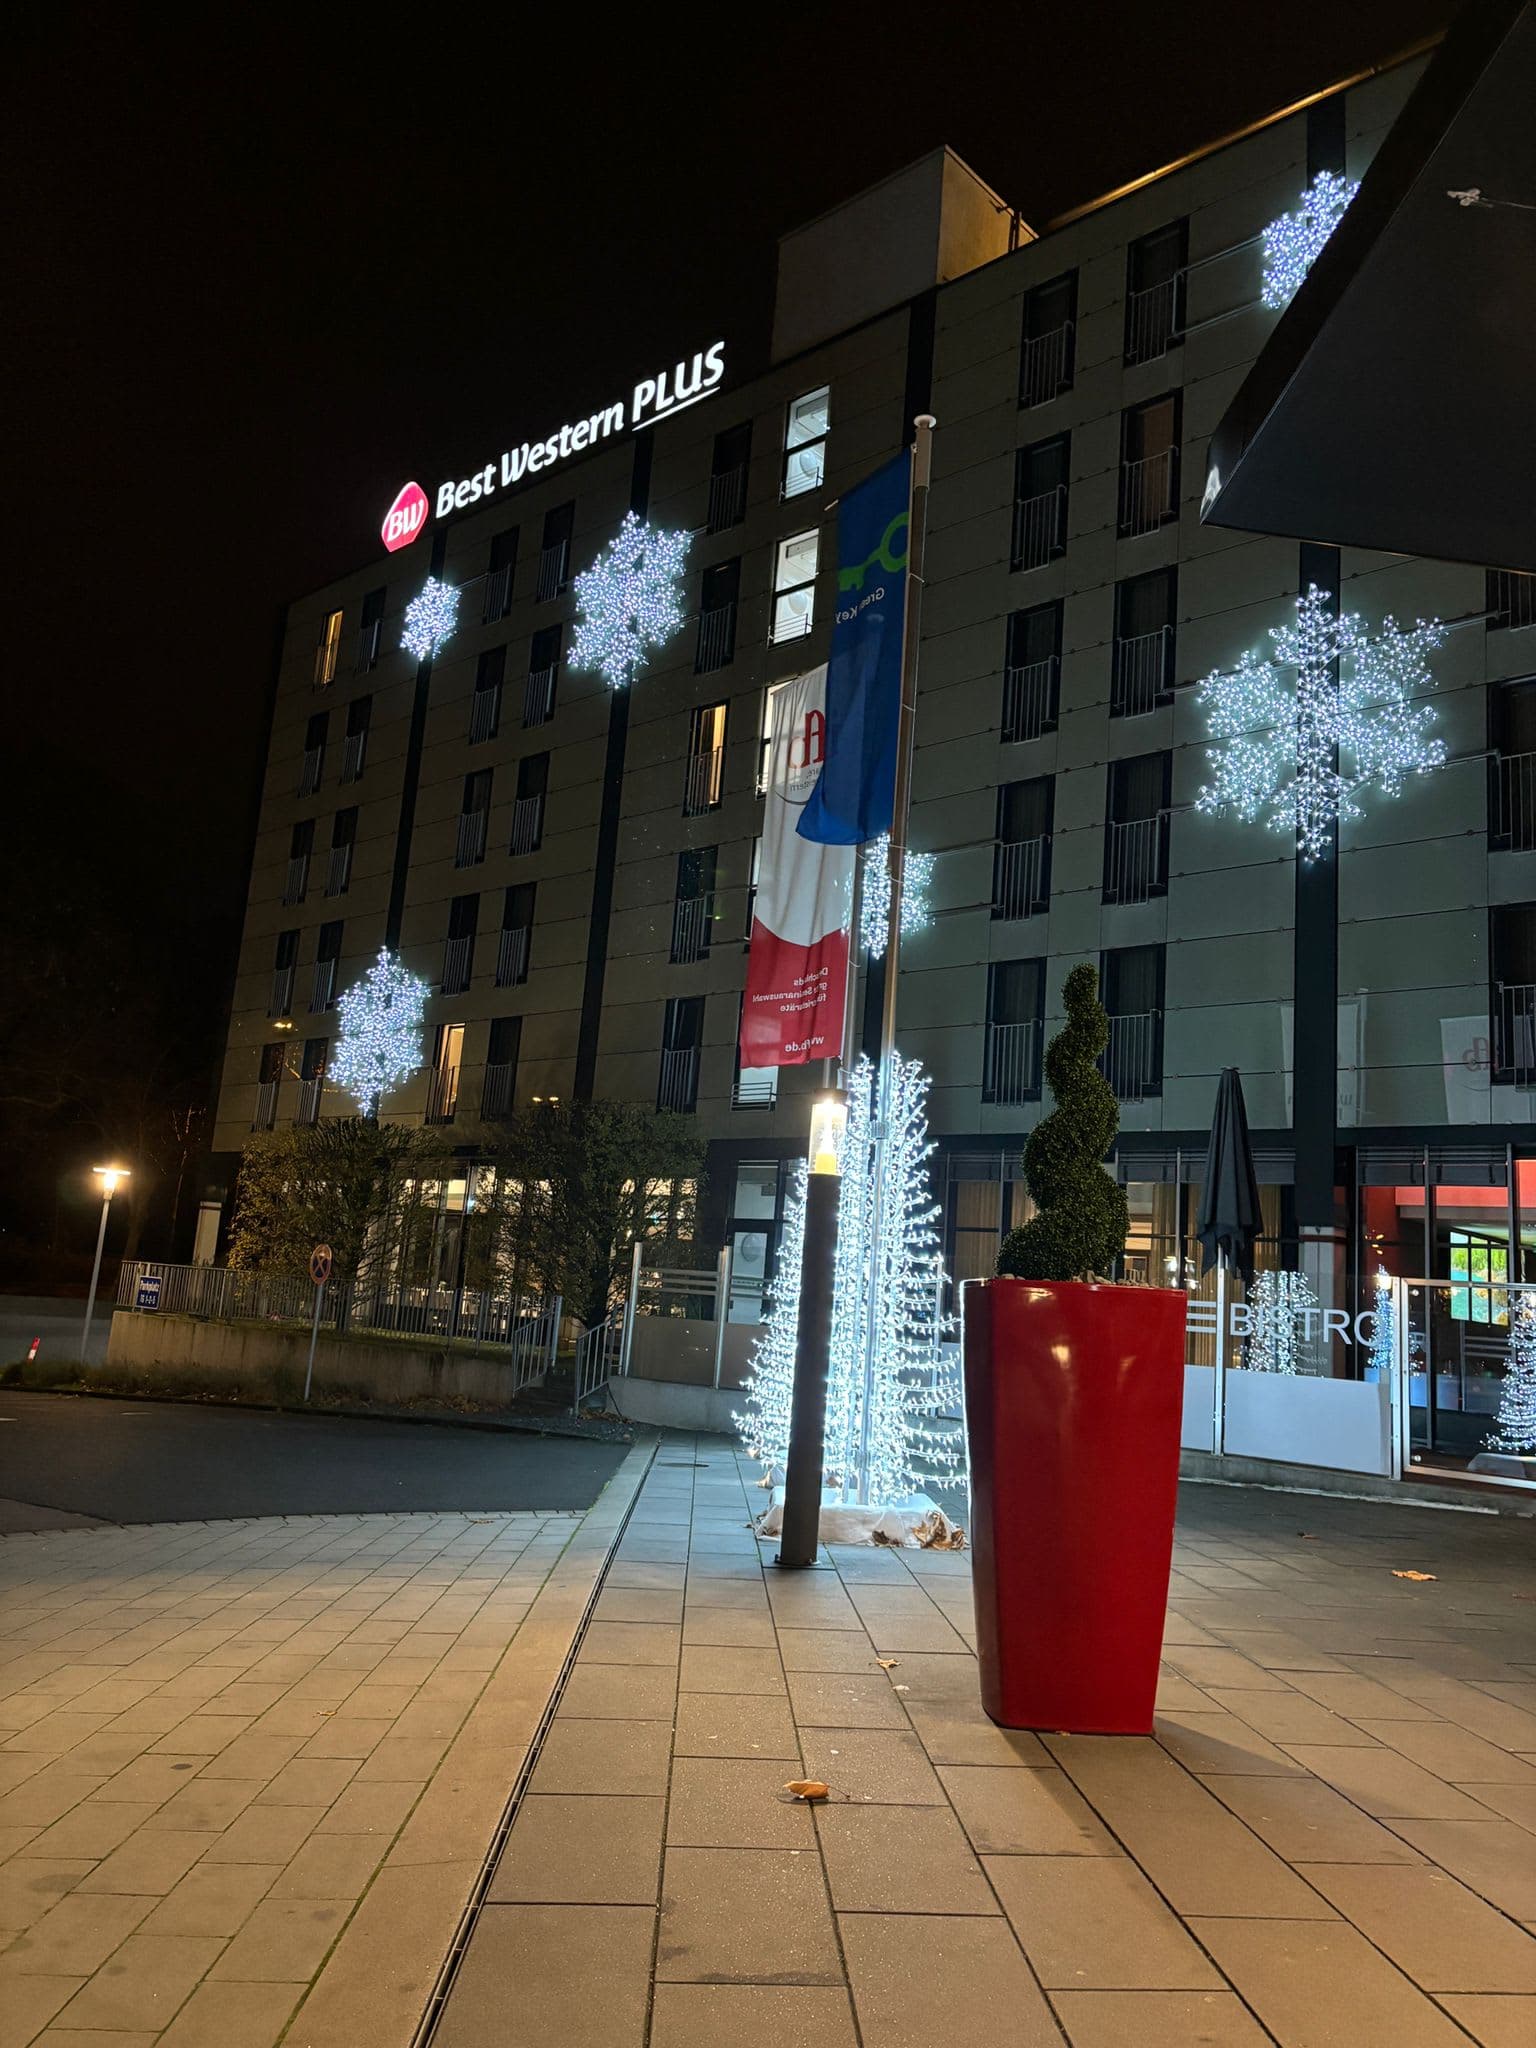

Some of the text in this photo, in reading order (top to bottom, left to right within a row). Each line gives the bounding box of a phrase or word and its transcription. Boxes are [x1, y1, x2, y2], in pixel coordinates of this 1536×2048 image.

[436, 341, 725, 519] Best Western PLUS
[387, 499, 425, 542] BW
[1229, 1302, 1387, 1348] BISTRO
